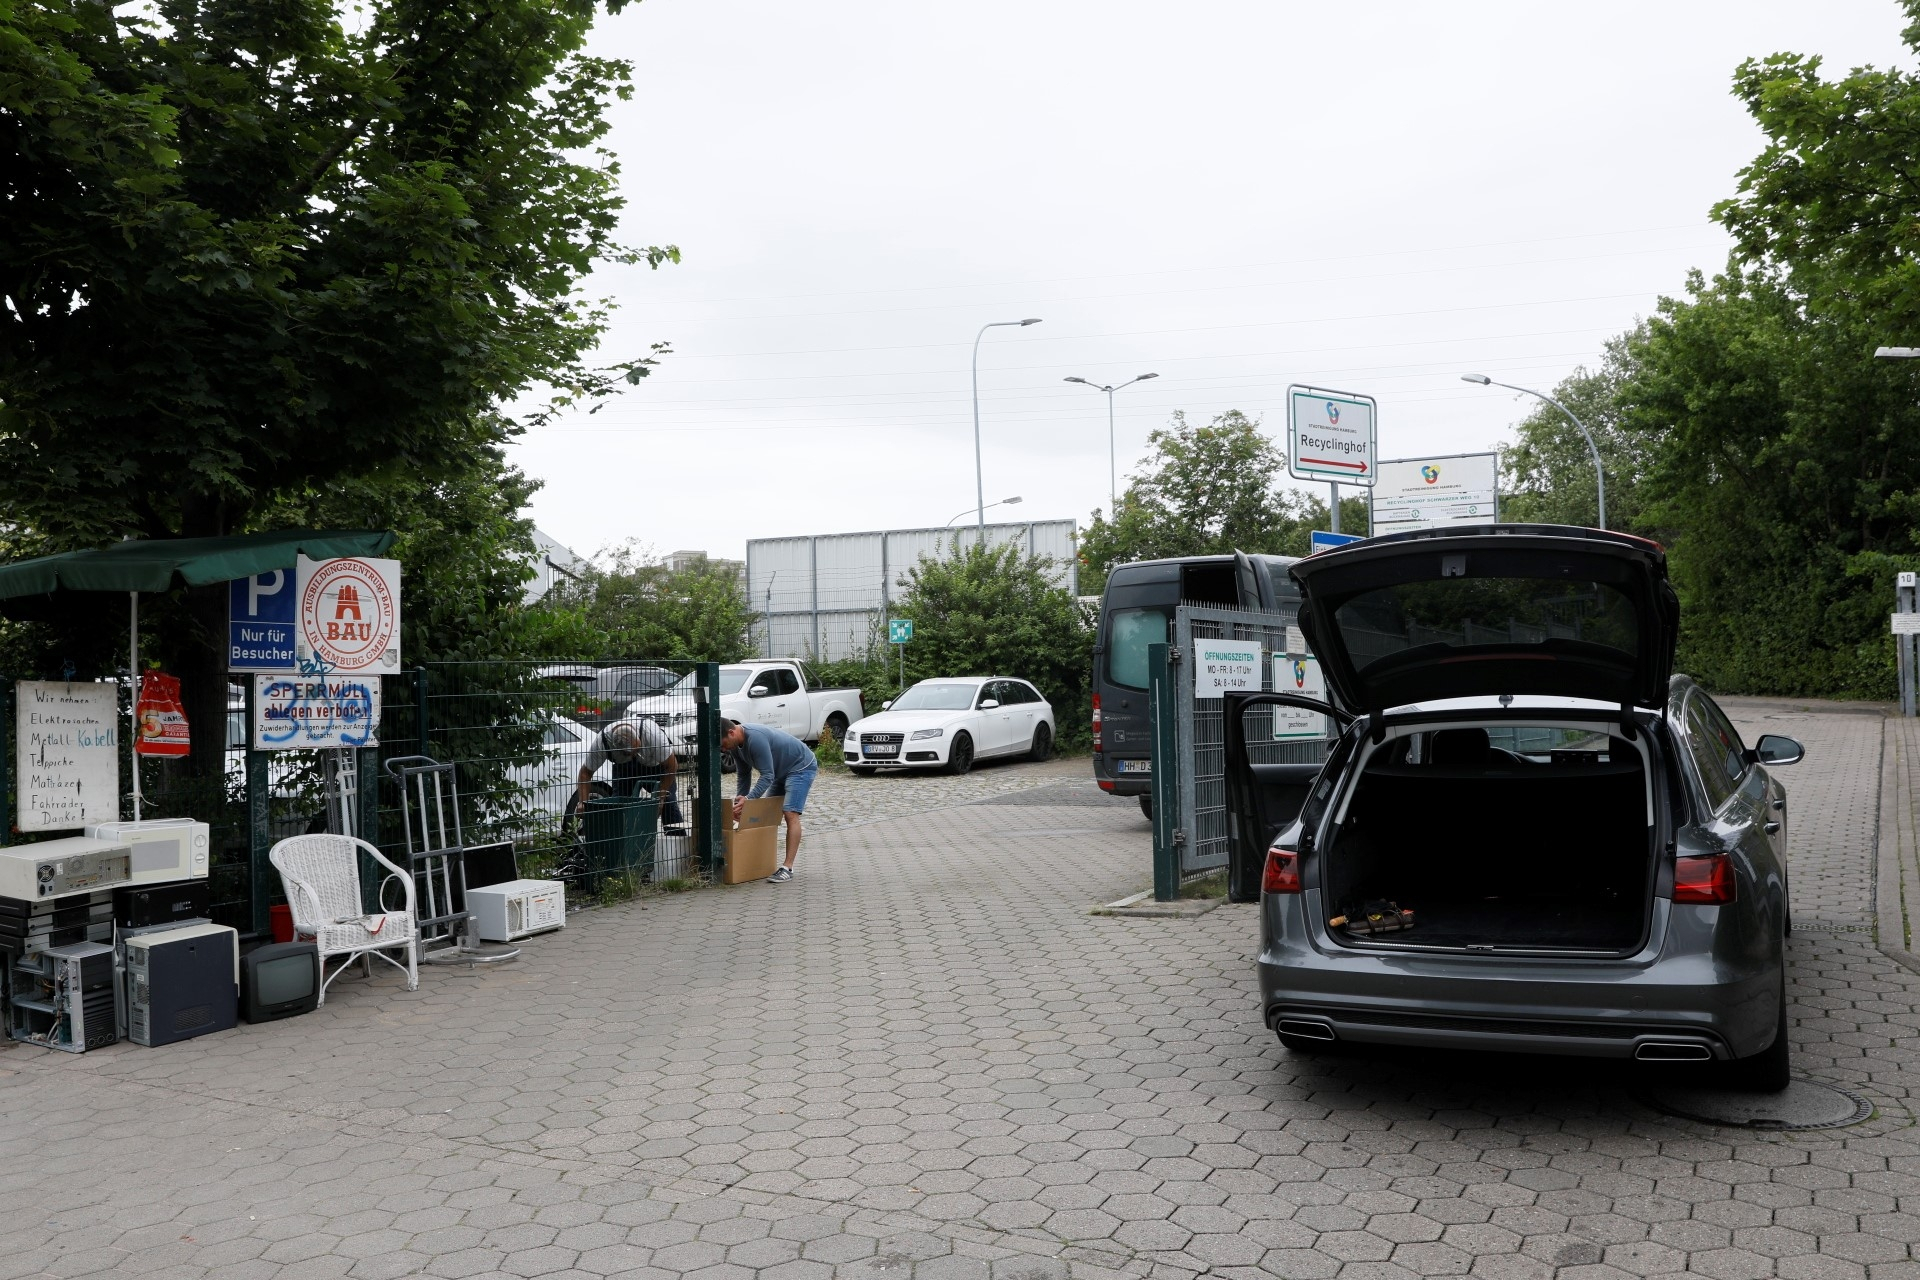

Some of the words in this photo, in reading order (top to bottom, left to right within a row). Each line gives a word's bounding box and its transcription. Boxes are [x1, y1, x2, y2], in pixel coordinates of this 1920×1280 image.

[1301, 434, 1366, 454] Recyclinghof
[249, 569, 285, 616] P
[241, 629, 265, 642] Nur
[268, 630, 285, 643] für
[327, 622, 371, 641] BAU
[232, 646, 294, 660] Besucher
[309, 630, 319, 644] IN
[318, 645, 365, 665] HAMBURG
[1204, 651, 1254, 661] ÖFFNUNGSZEITEN
[1207, 665, 1216, 674] MO
[1220, 665, 1228, 674] FR:
[1243, 666, 1252, 674] Uhr
[270, 680, 368, 698] SPERRMÜLL
[1214, 678, 1222, 687] SA:
[1231, 679, 1236, 687] 14
[1238, 679, 1246, 687] Uhr
[35, 688, 54, 703] Wir
[31, 712, 100, 724] Elektrosachen
[264, 703, 312, 719] ablegen
[316, 703, 373, 718] verboten!
[78, 728, 116, 748] Kabell
[1125, 762, 1135, 771] HH
[1141, 762, 1146, 770] D
[42, 811, 76, 825] Danke
